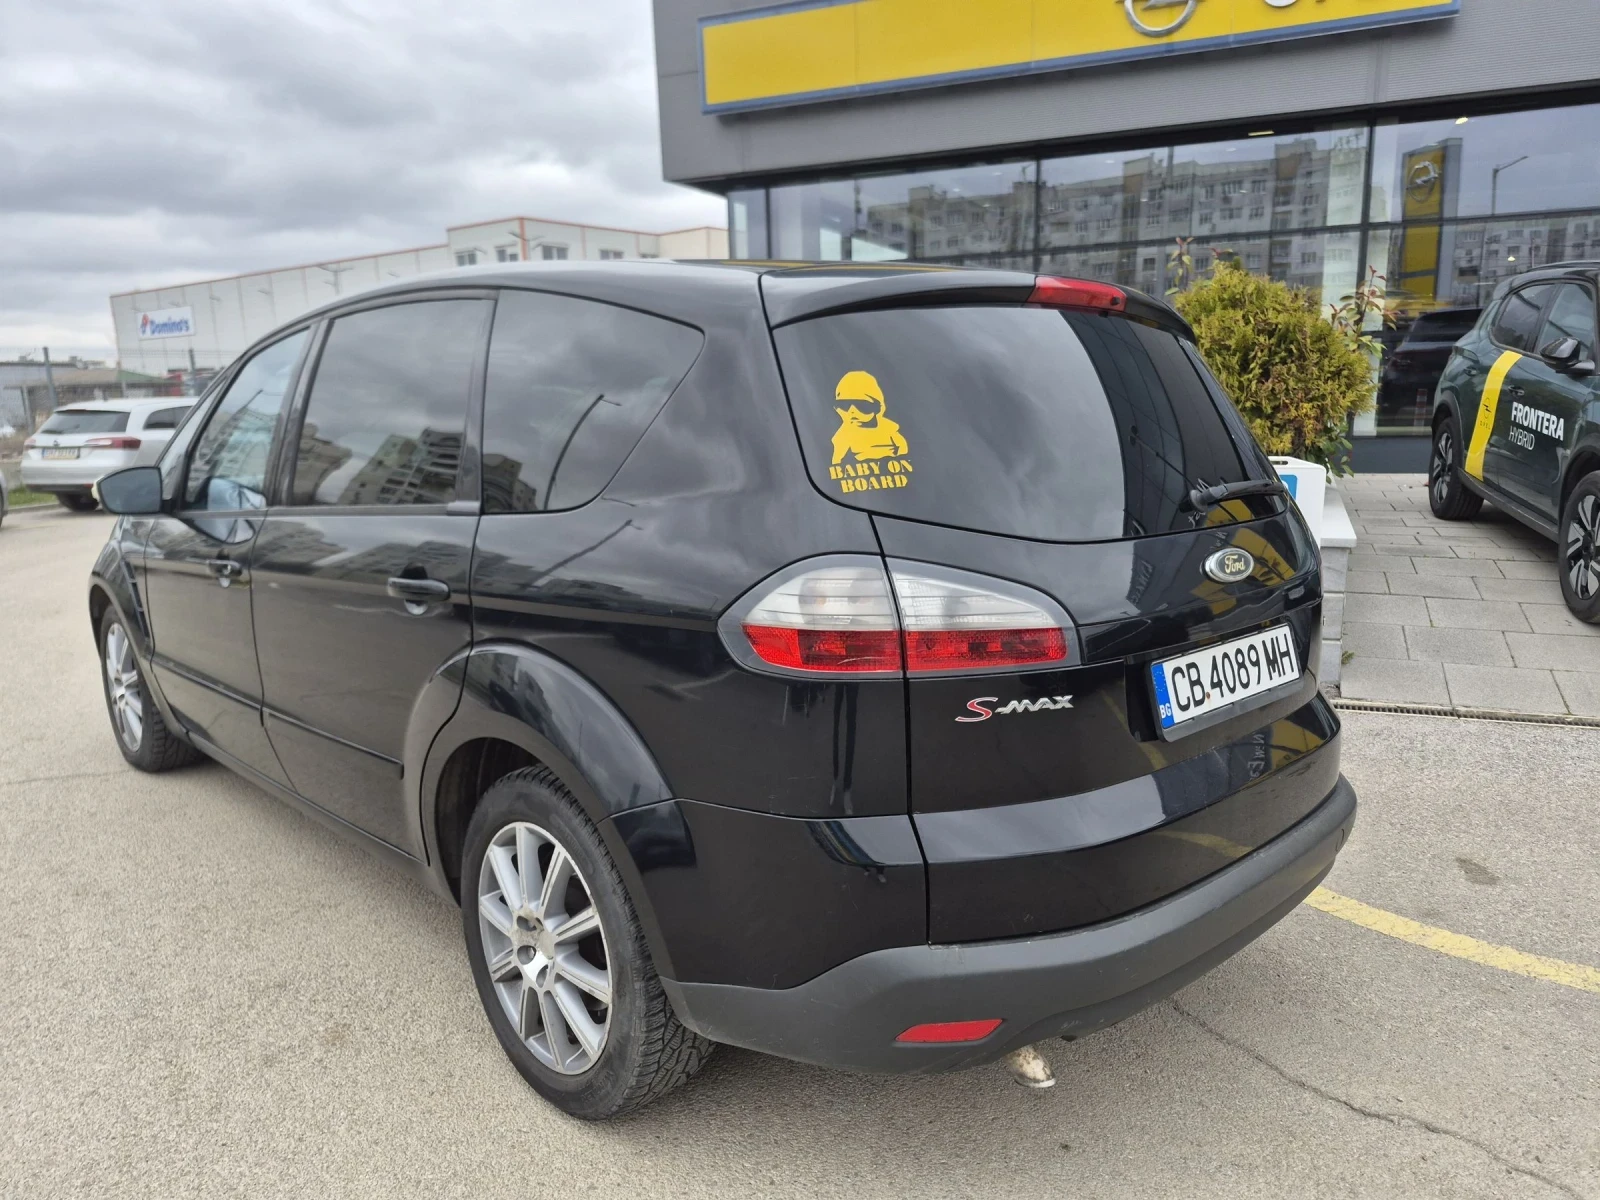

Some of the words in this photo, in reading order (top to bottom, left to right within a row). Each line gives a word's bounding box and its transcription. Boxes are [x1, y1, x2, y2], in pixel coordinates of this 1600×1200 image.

[1511, 401, 1565, 441] FRONTERA
[1508, 426, 1536, 451] HYBRID
[828, 461, 881, 480] BABY
[887, 459, 913, 474] ON
[840, 474, 908, 494] BOARD
[1224, 554, 1246, 574] Ford
[1159, 703, 1172, 719] BG
